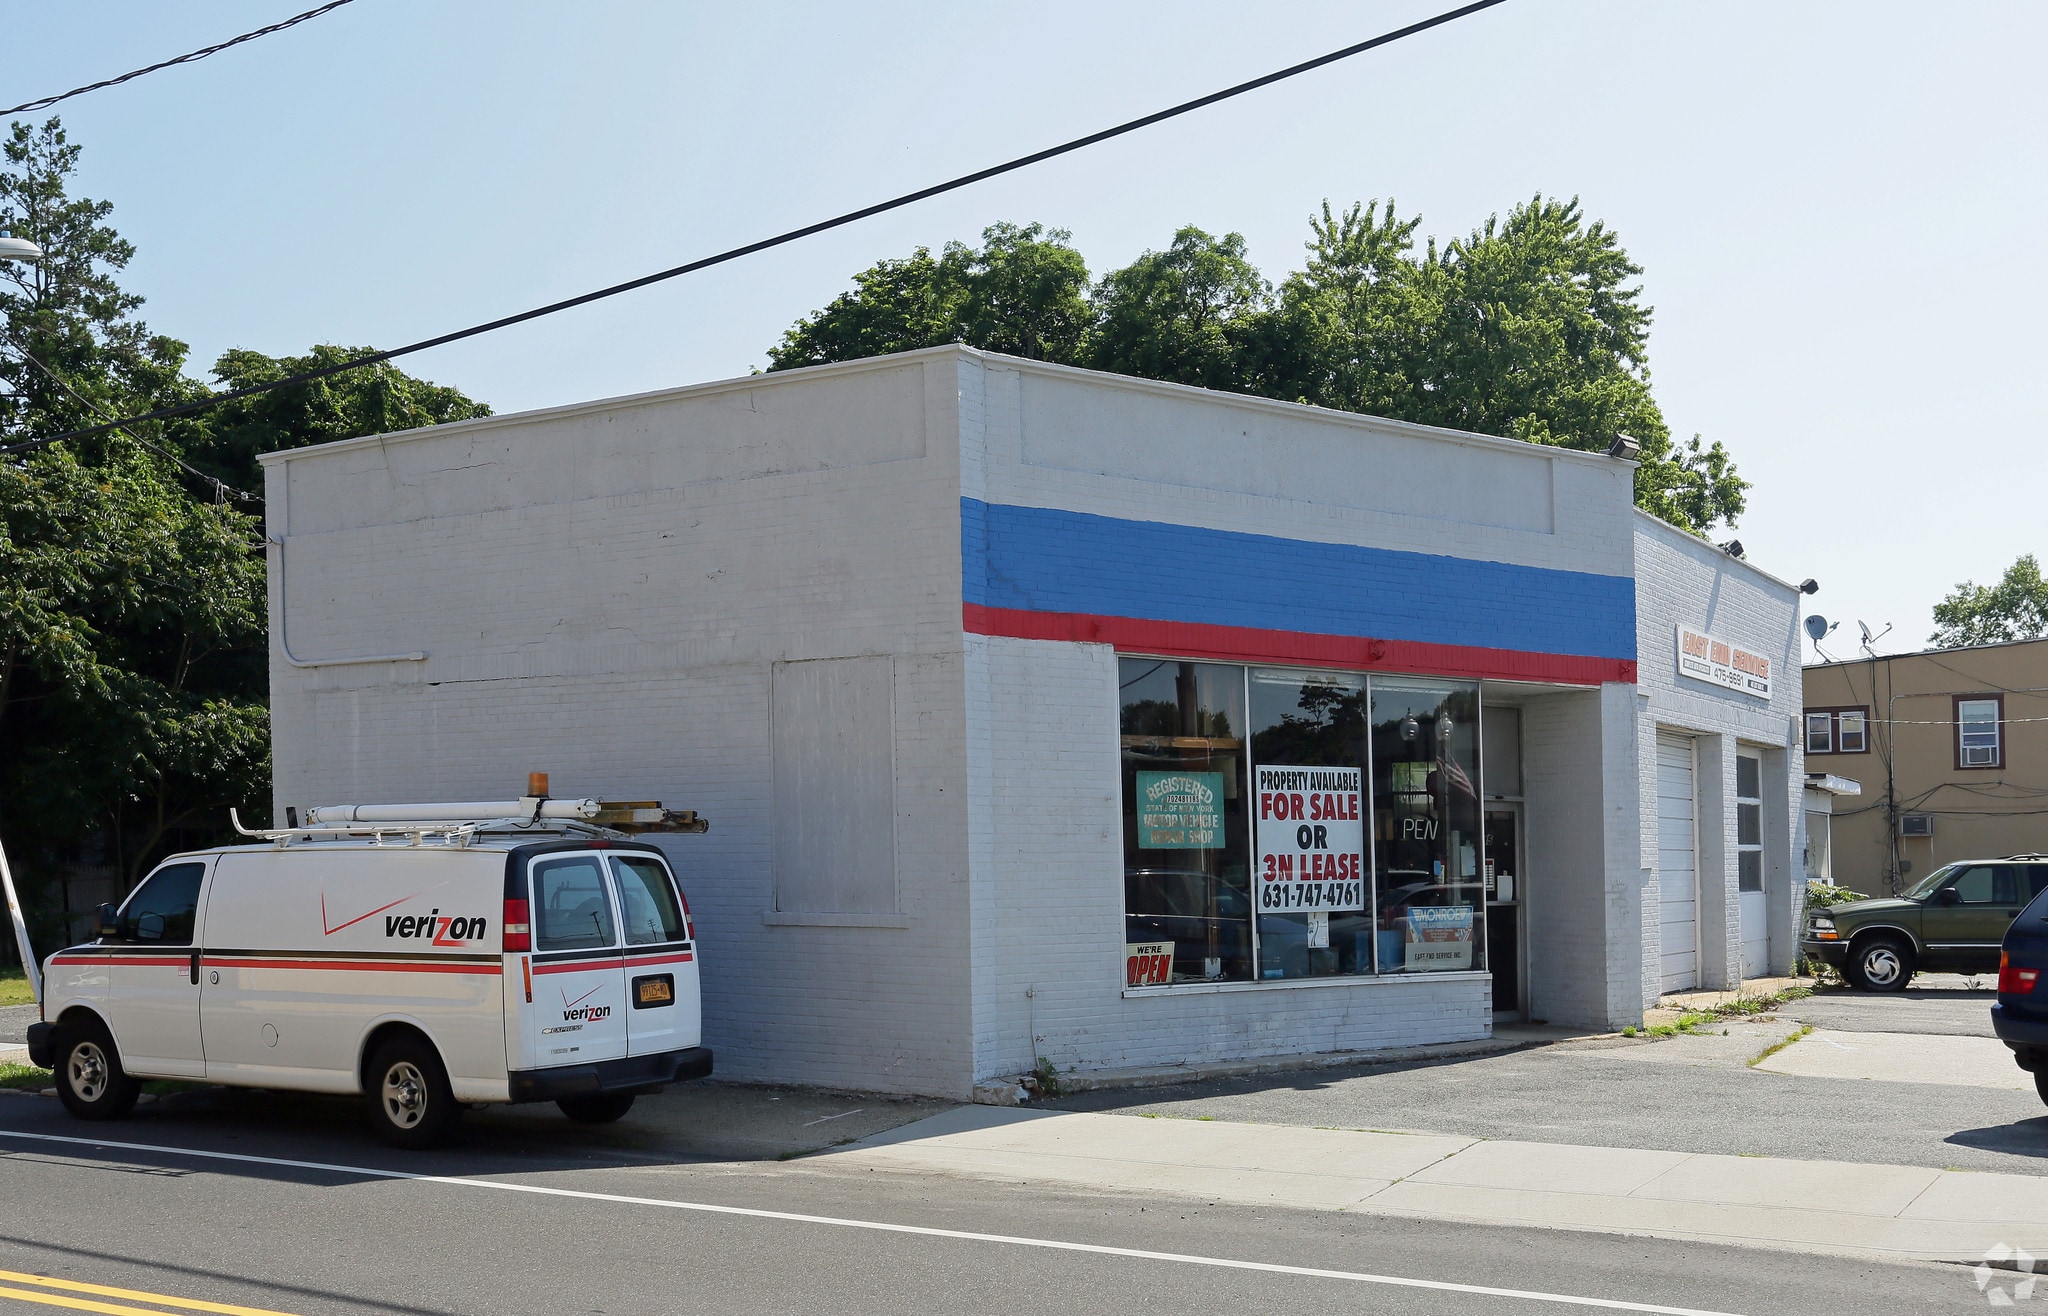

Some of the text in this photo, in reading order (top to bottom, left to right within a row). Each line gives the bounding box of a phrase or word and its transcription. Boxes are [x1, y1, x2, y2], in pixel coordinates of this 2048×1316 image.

[1682, 630, 1709, 660] EAST
[1710, 640, 1731, 667] END
[1732, 648, 1769, 680] SERVICE
[1146, 777, 1213, 804] REGISTERED
[1260, 771, 1358, 791] PROPERTY AVAILABLE
[1146, 804, 1168, 812] STATE
[1179, 804, 1194, 812] NEW
[1197, 804, 1214, 813] YORK
[1261, 792, 1359, 820] FOR SALE
[1143, 814, 1219, 828] MOTOR VEHICLE
[1189, 830, 1213, 844] SHOP
[1296, 824, 1328, 850] OR
[1300, 853, 1360, 880] LEASE
[1263, 883, 1360, 908] 631-747-4761
[1420, 908, 1460, 921] MONROE
[385, 908, 487, 947] verizon
[1137, 945, 1163, 954] WE'RE
[1126, 954, 1171, 985] OPEN
[563, 1004, 611, 1022] verizon
